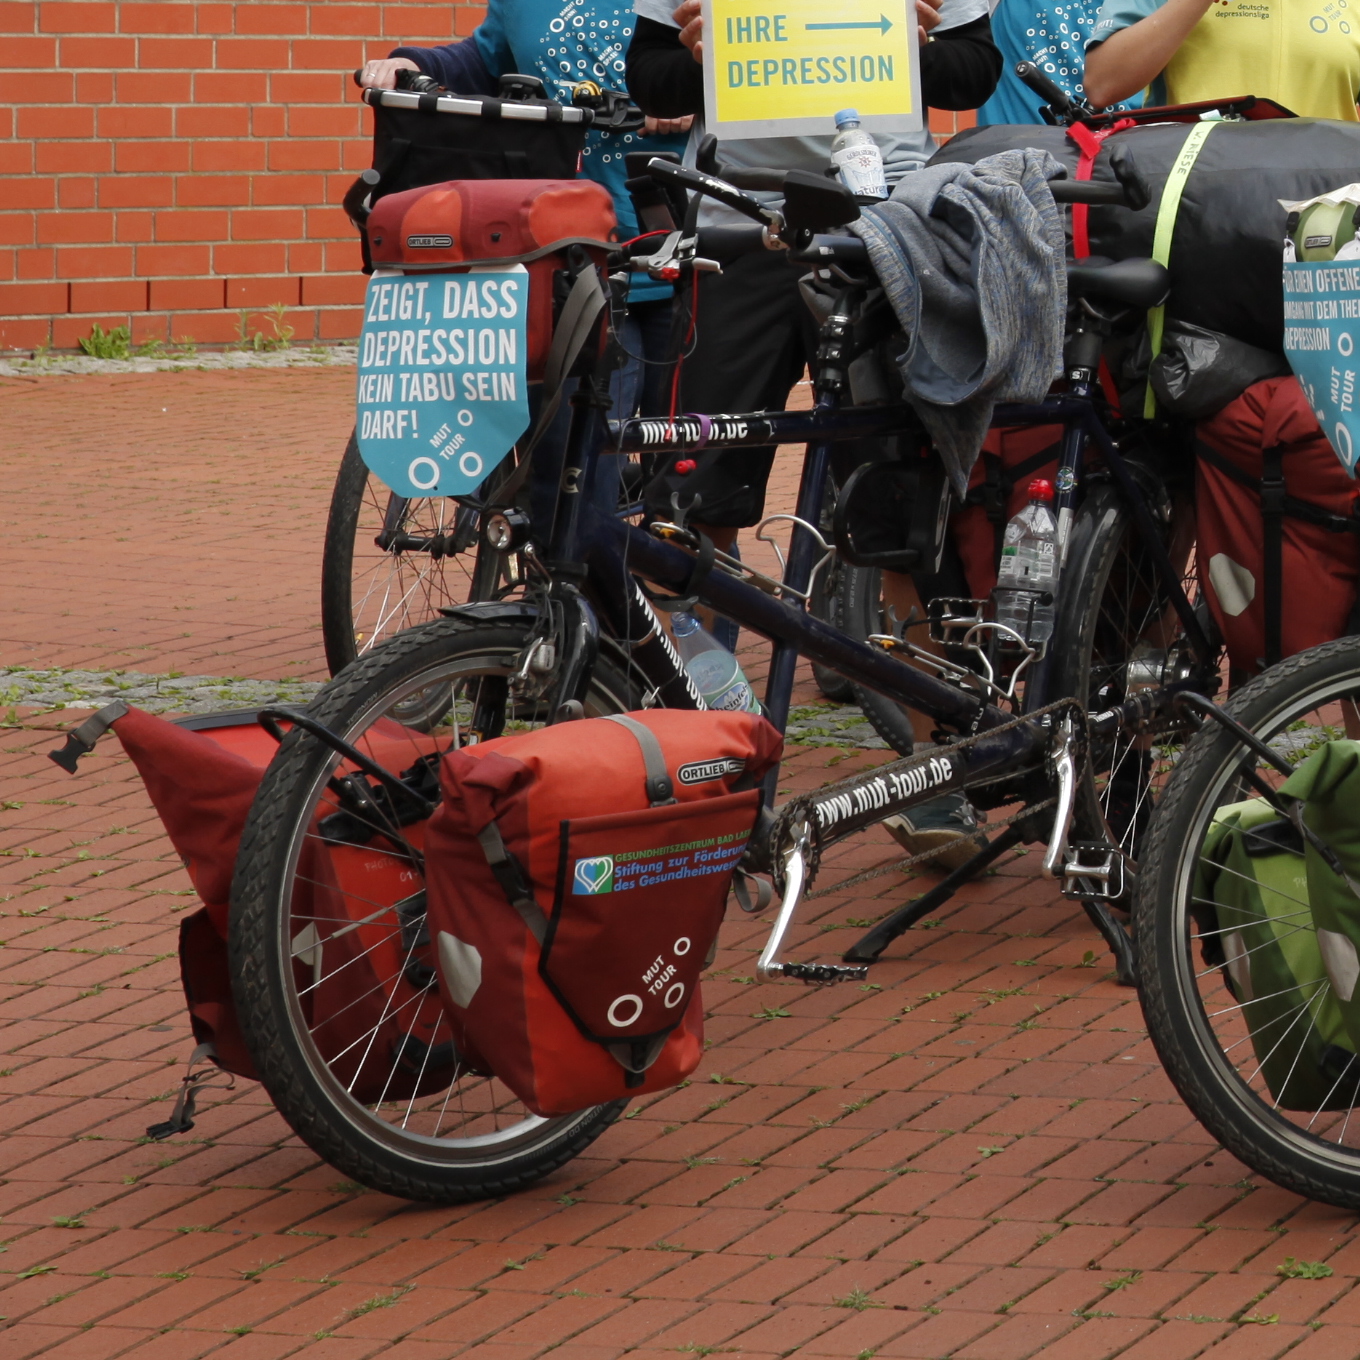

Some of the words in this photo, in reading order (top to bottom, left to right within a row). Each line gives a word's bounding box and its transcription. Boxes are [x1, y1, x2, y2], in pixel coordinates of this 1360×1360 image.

[726, 14, 788, 44] IHRE
[727, 55, 894, 88] DEPRESSION
[367, 281, 431, 326] ZEIGT,
[442, 279, 518, 320] DASS
[1316, 300, 1338, 320] DEM
[362, 328, 517, 367] DEPRESSION
[1284, 327, 1330, 351] DEPRESSION
[358, 373, 396, 403] KEIN
[399, 372, 454, 401] TABU
[463, 372, 516, 401] SEIN
[1330, 366, 1342, 405] MUT
[1340, 369, 1357, 413] TOUR
[361, 410, 418, 440] DARF!
[429, 422, 453, 449] MUT
[438, 433, 466, 461] TOUR
[682, 763, 726, 781] ORTLIEB
[615, 837, 715, 863] GESUNDHEITSZENTRUM
[717, 835, 734, 846] BAD
[614, 859, 664, 879] Stiftung
[668, 855, 690, 868] zur
[614, 878, 636, 892] des
[641, 954, 666, 985] MUT
[648, 964, 678, 997] TOUR
